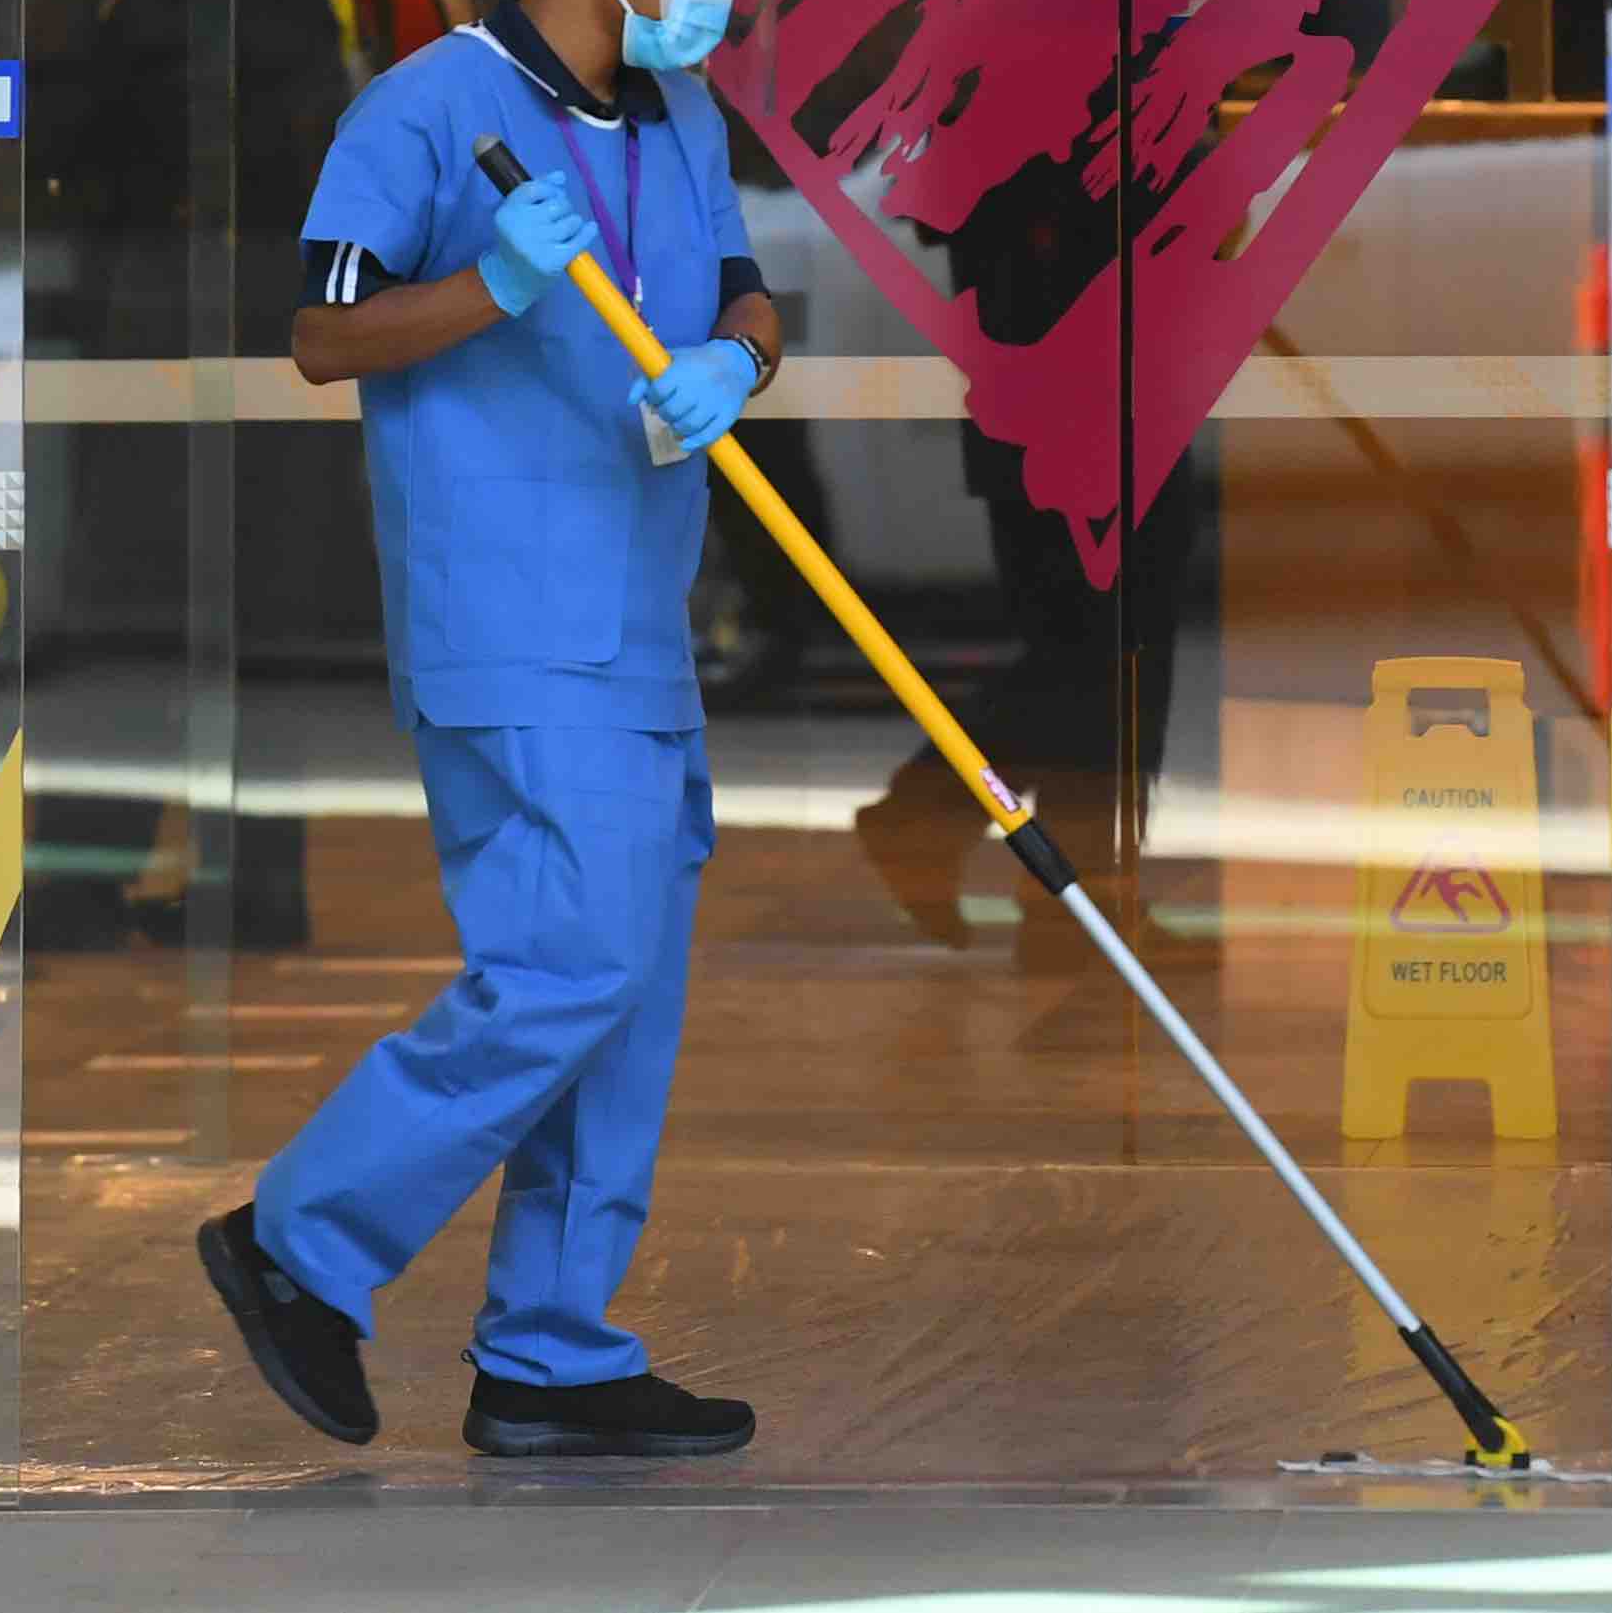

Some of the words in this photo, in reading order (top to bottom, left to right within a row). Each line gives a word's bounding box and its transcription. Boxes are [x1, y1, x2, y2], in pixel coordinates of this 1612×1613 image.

[1403, 788, 1493, 809] CAUTION
[1391, 961, 1433, 983] WET
[1440, 961, 1507, 983] FLOOR
